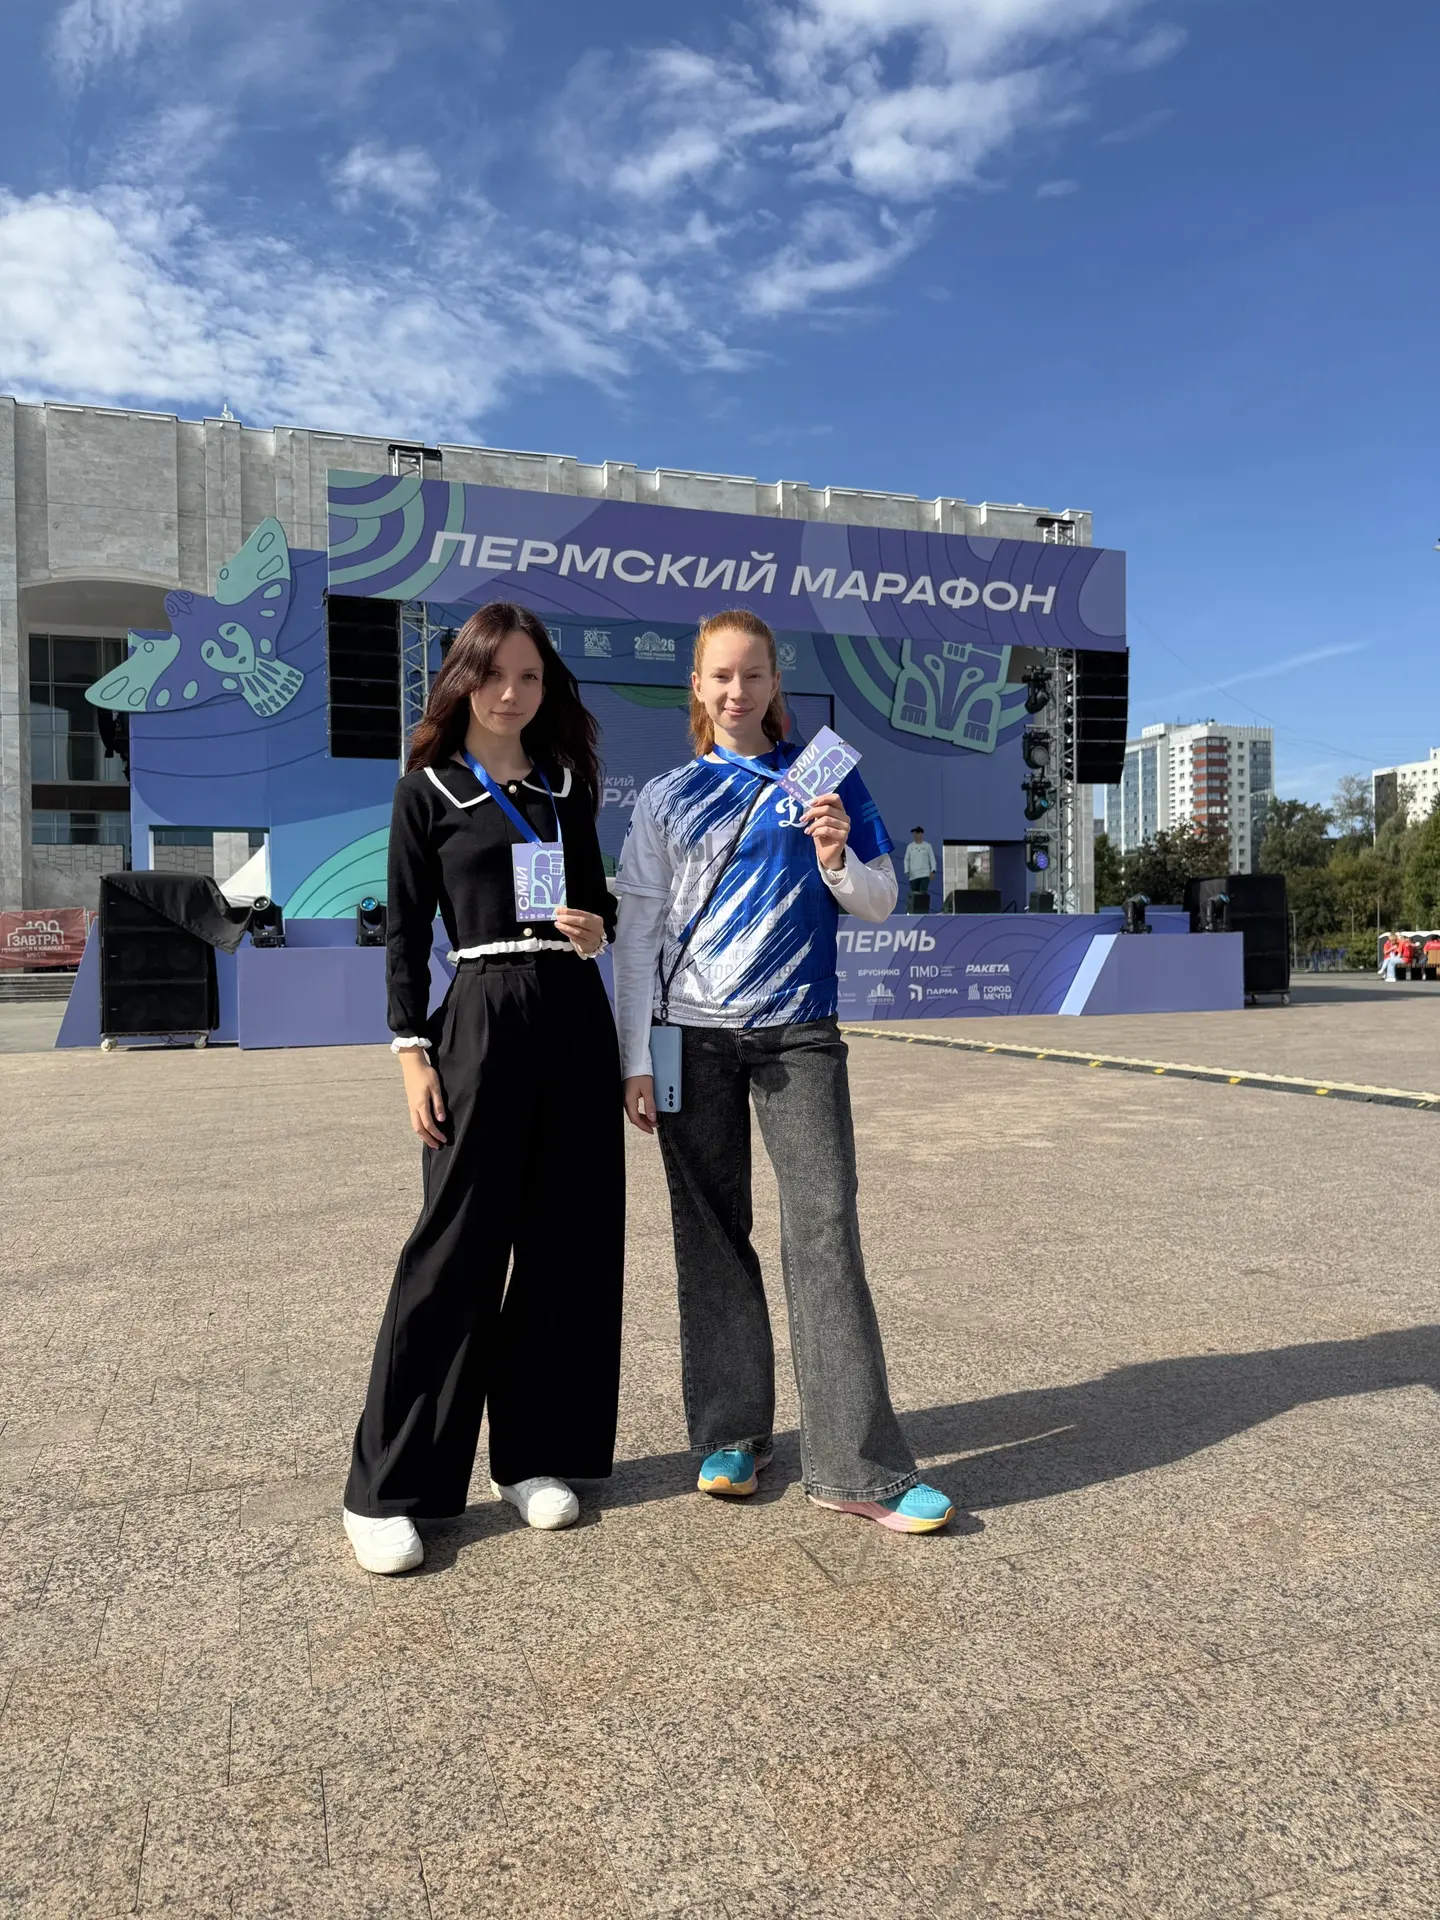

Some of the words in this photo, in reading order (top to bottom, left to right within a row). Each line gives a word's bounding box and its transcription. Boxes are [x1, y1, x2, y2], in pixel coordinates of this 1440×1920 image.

[429, 531, 777, 595] ПЕРМСКИЙ
[790, 565, 1056, 615] МАРАФОН
[787, 743, 821, 781] СМИ
[515, 865, 531, 911] СМИ
[12, 934, 60, 947] ЗАВТРА
[835, 930, 936, 953] ПЕРМЬ
[965, 963, 1010, 973] РАКЕТА
[926, 987, 959, 996] ПАРМА
[983, 985, 1012, 993] ГОРОД
[983, 992, 1013, 1000] МЕЧТЫ
